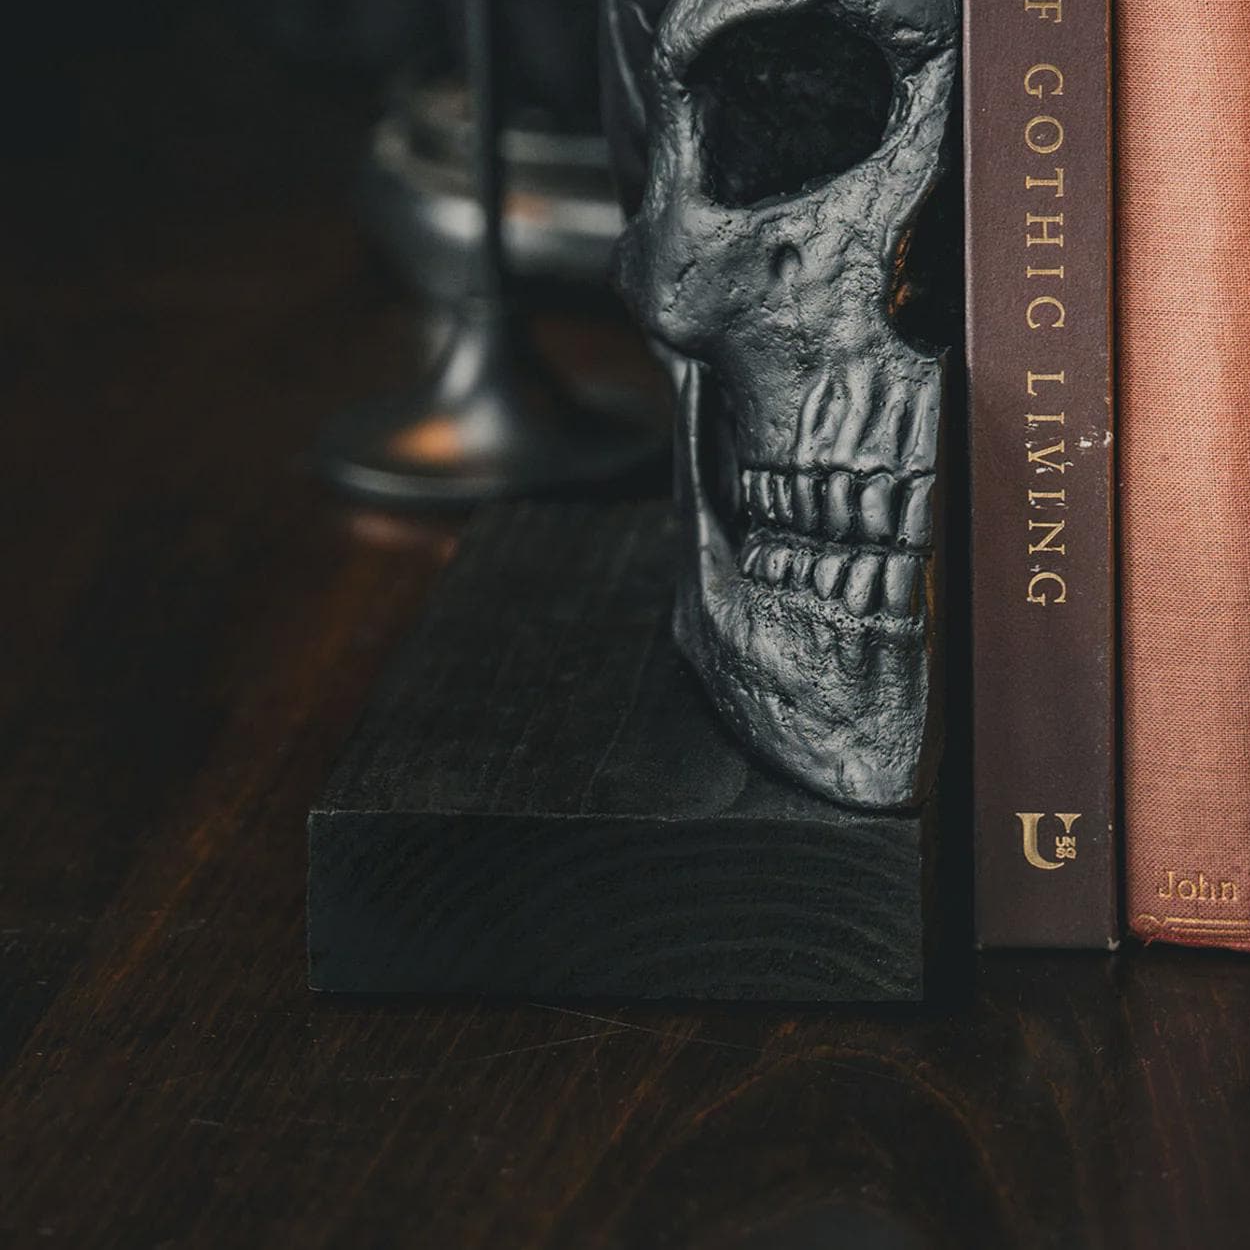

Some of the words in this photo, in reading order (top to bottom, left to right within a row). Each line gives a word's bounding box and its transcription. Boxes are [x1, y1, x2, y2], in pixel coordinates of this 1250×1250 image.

[1023, 62, 1066, 331] GOTHIC
[1025, 369, 1067, 607] LIVING
[1158, 870, 1239, 901] John
